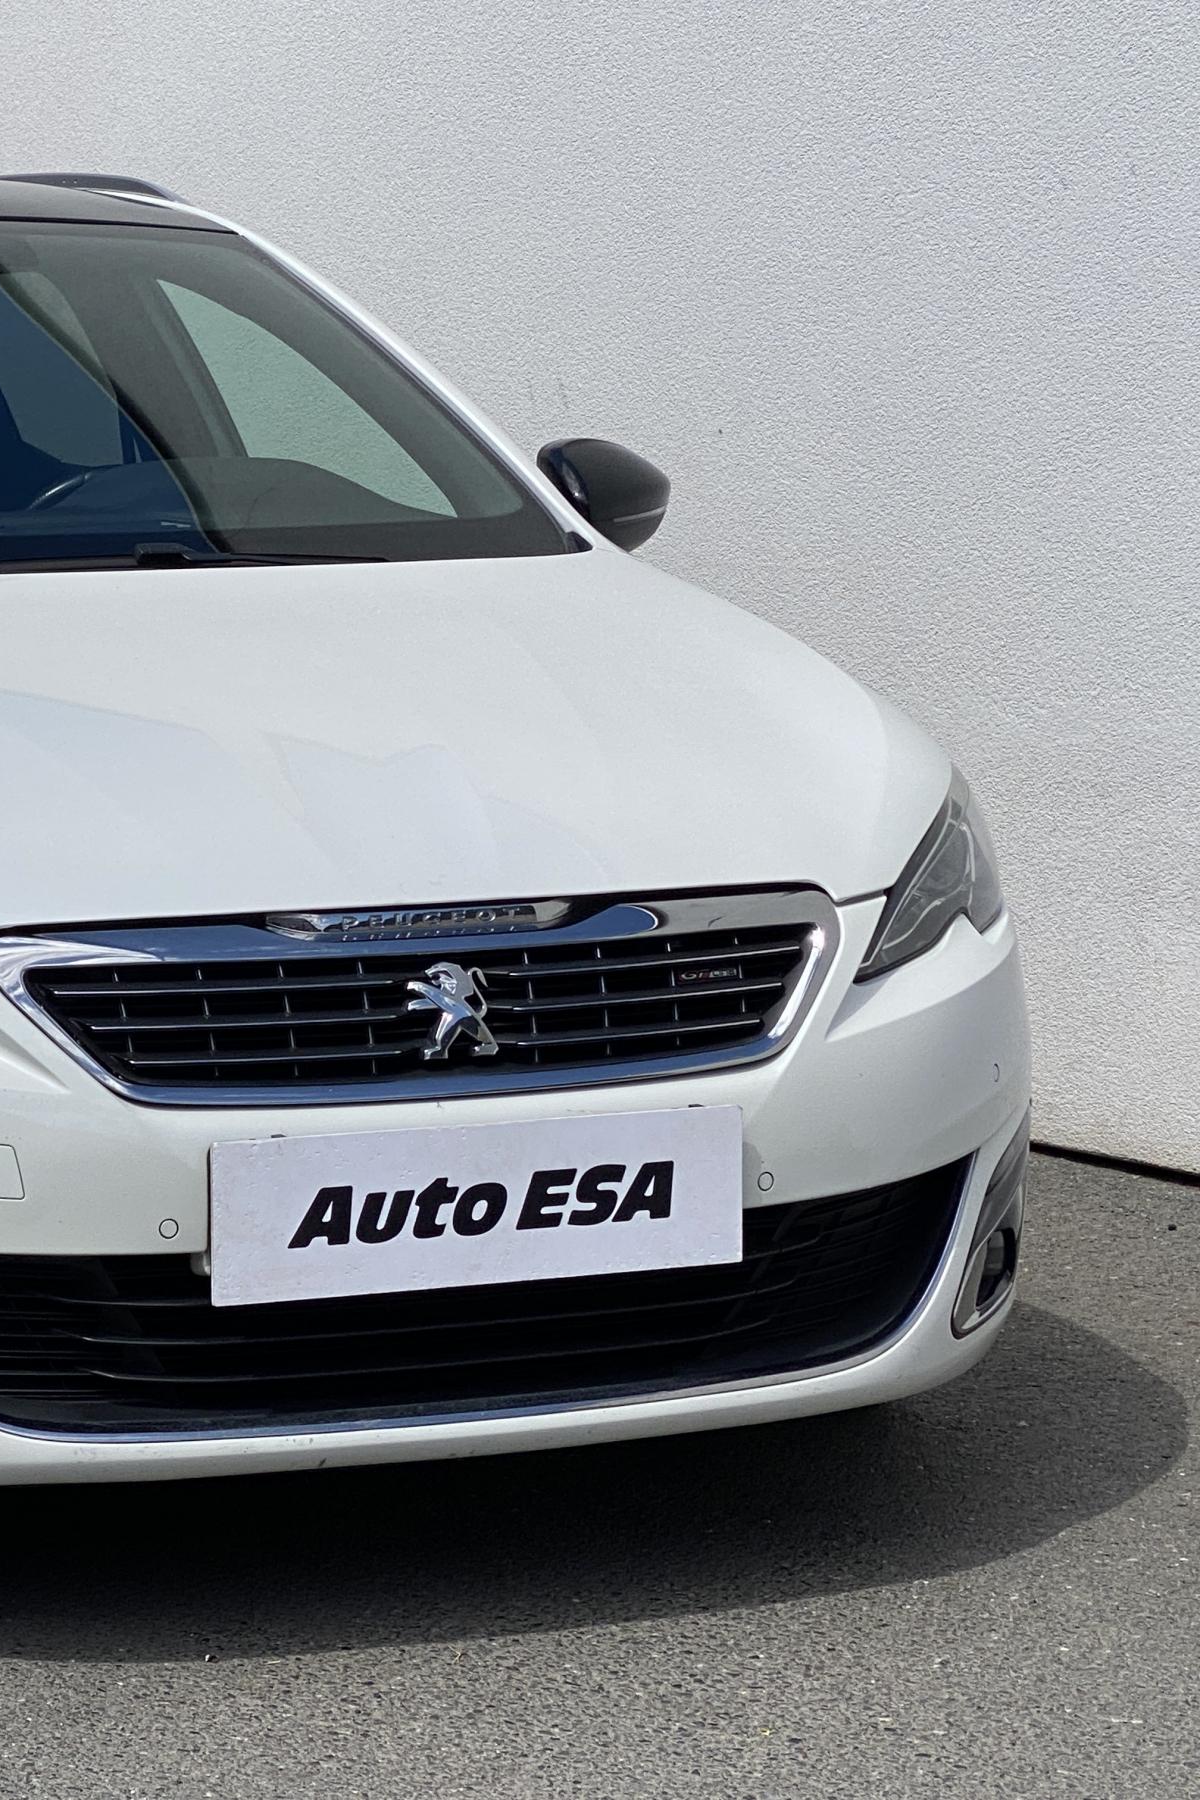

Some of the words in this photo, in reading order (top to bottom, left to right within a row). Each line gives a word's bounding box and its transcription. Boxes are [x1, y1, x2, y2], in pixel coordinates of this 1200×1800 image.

[341, 907, 521, 931] PEUGEOT
[287, 1177, 507, 1249] Auto
[516, 1160, 674, 1231] ESA
